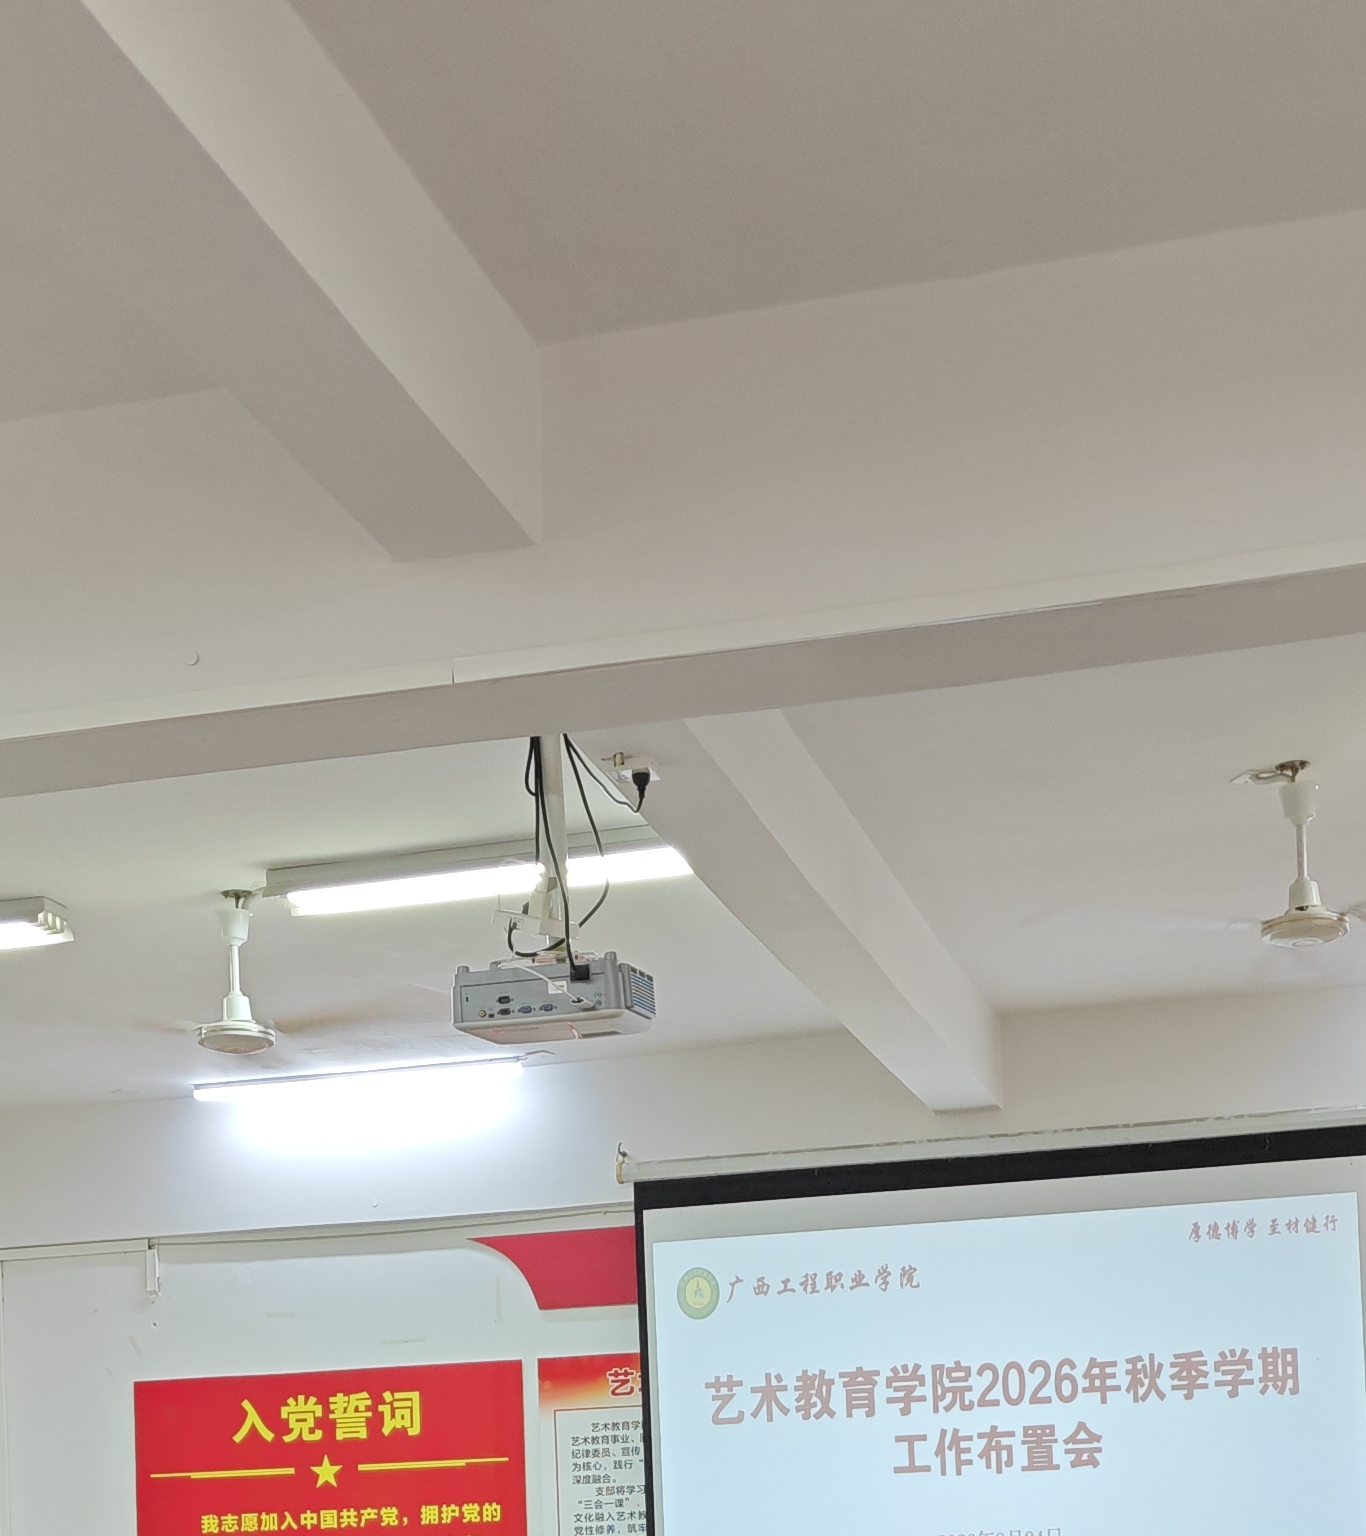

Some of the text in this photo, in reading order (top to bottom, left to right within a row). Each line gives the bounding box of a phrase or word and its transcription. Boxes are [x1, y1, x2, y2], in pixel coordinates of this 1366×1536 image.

[1188, 1217, 1258, 1243] 厚德博学
[726, 1263, 921, 1303] 广西工程职业学院
[606, 1367, 642, 1398] 艺
[704, 1346, 1301, 1427] 艺术教育学院2026年秋季学期
[232, 1391, 423, 1444] 入党誓词
[591, 1419, 643, 1433] 艺术教育学
[571, 1432, 643, 1447] 艺术教育事业、
[892, 1420, 1103, 1477] 工作布置会
[572, 1473, 617, 1486] 深度融合。
[200, 1502, 502, 1534] 我志愿加入中国共产党，拥护党的
